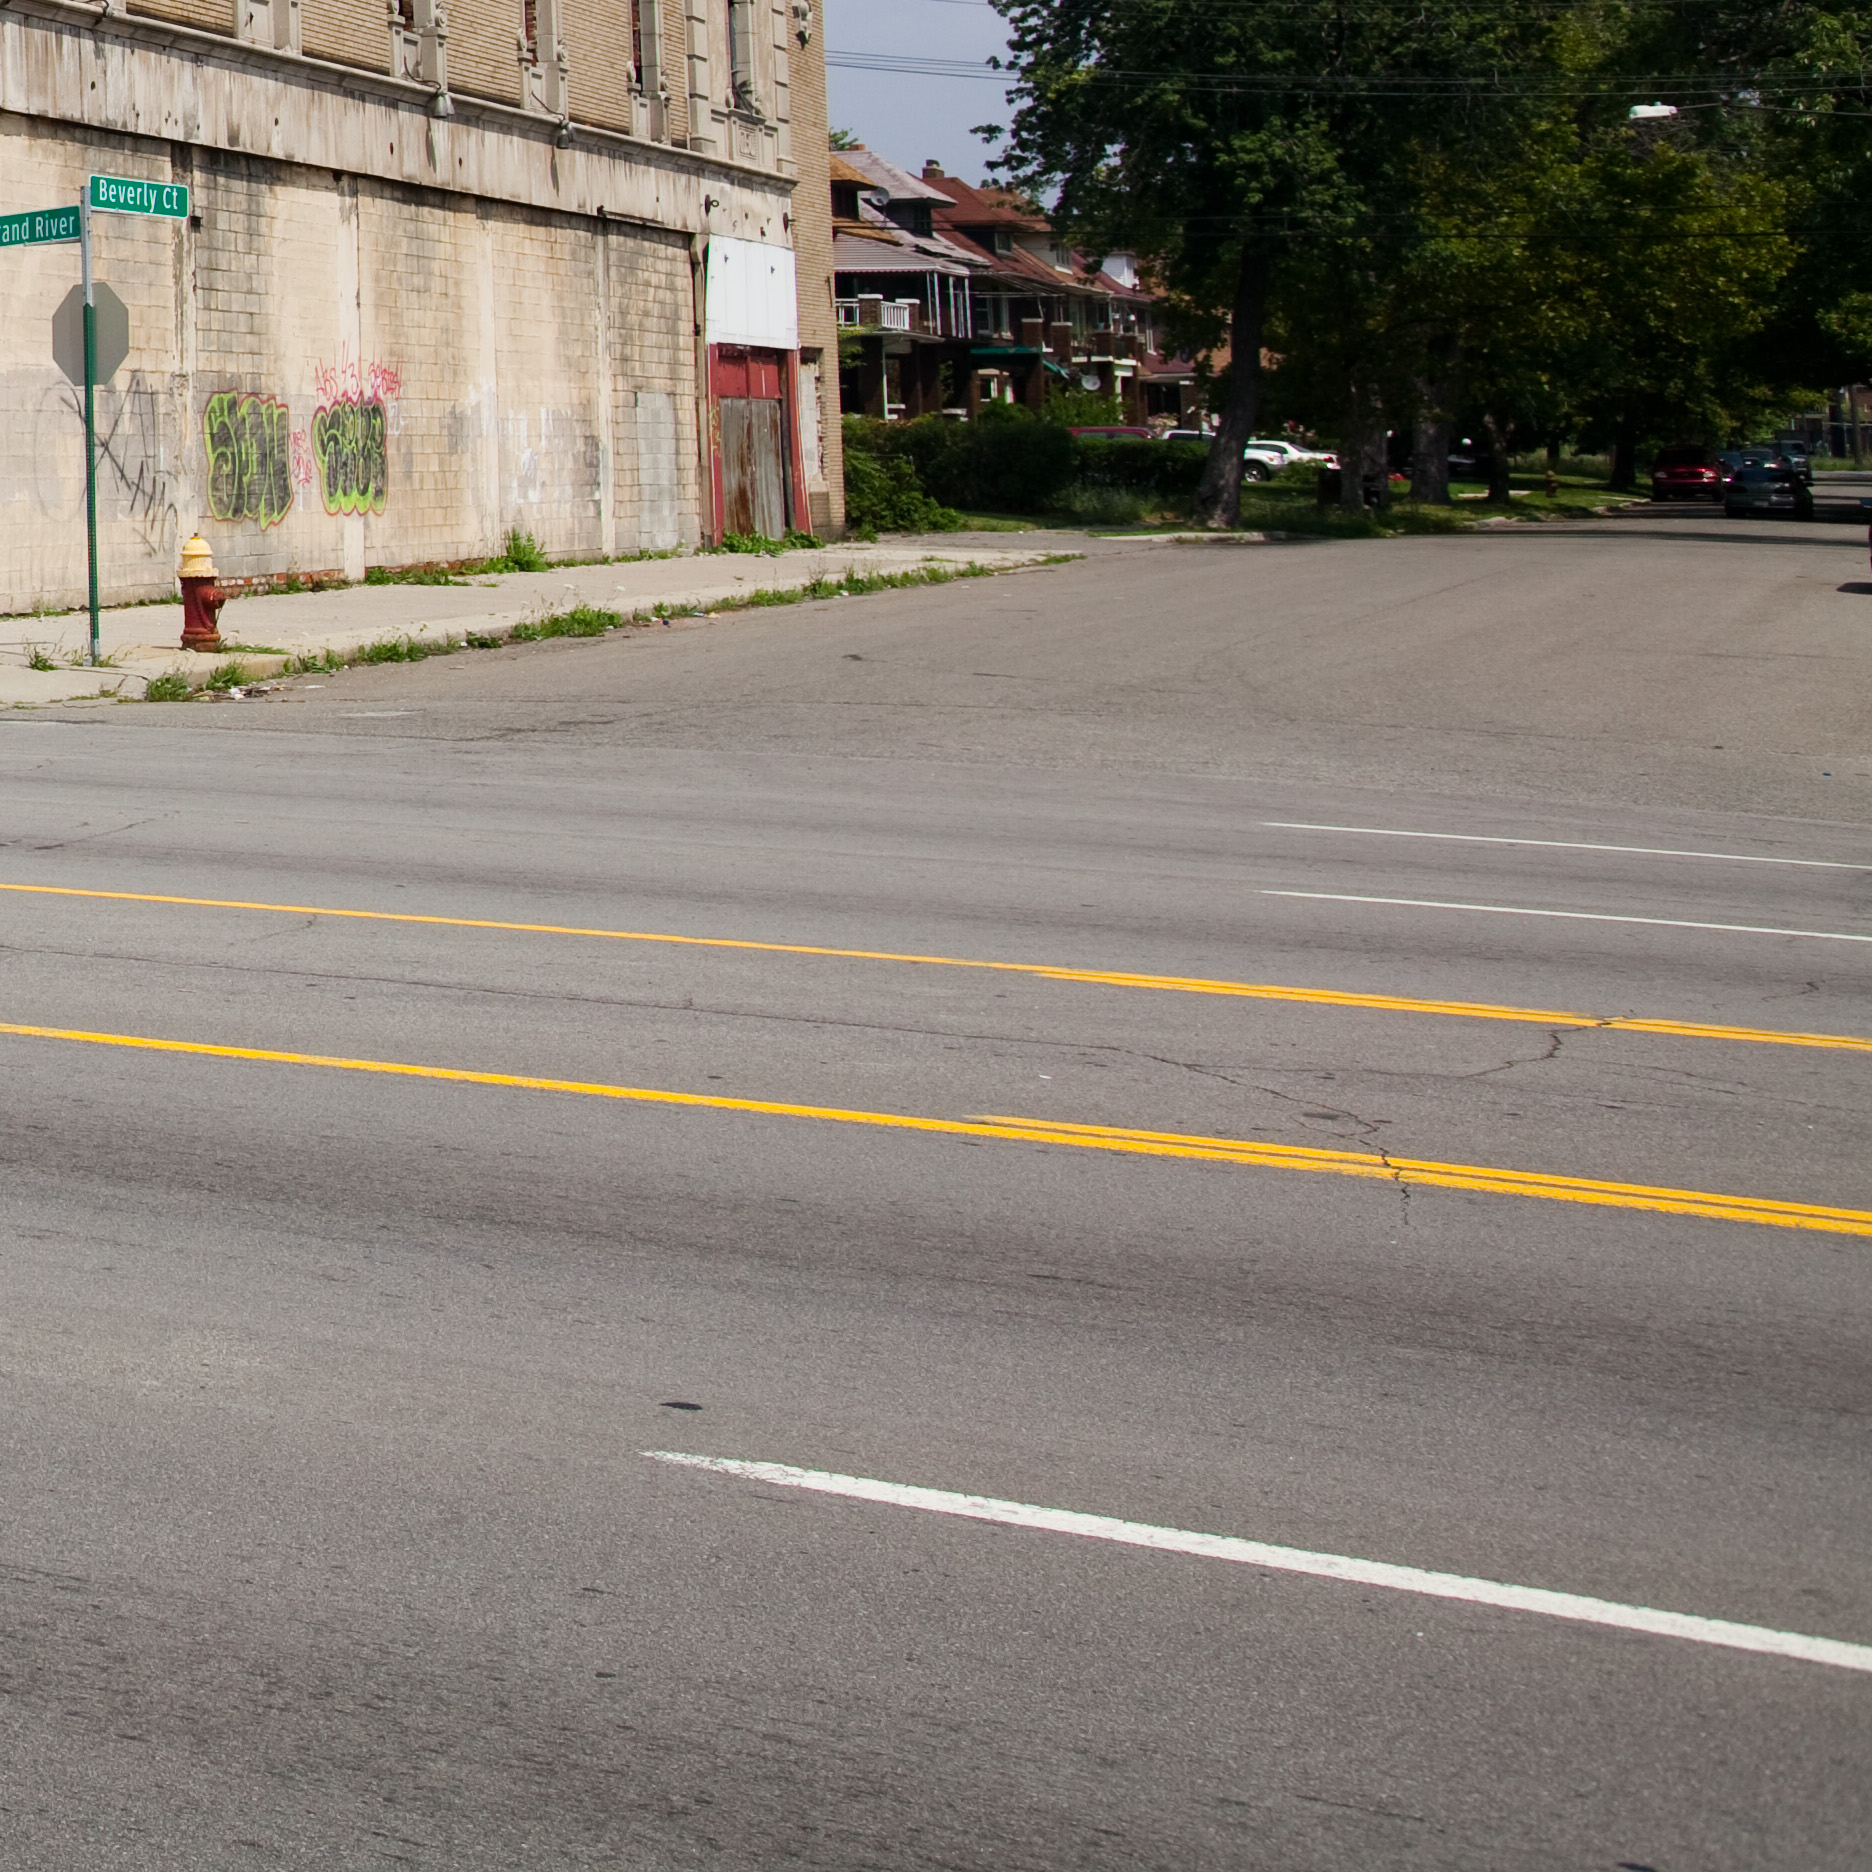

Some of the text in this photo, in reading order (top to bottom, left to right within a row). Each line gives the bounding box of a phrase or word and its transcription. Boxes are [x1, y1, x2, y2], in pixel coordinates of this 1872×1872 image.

[99, 179, 178, 213] Beverly Ct
[36, 213, 75, 238] River
